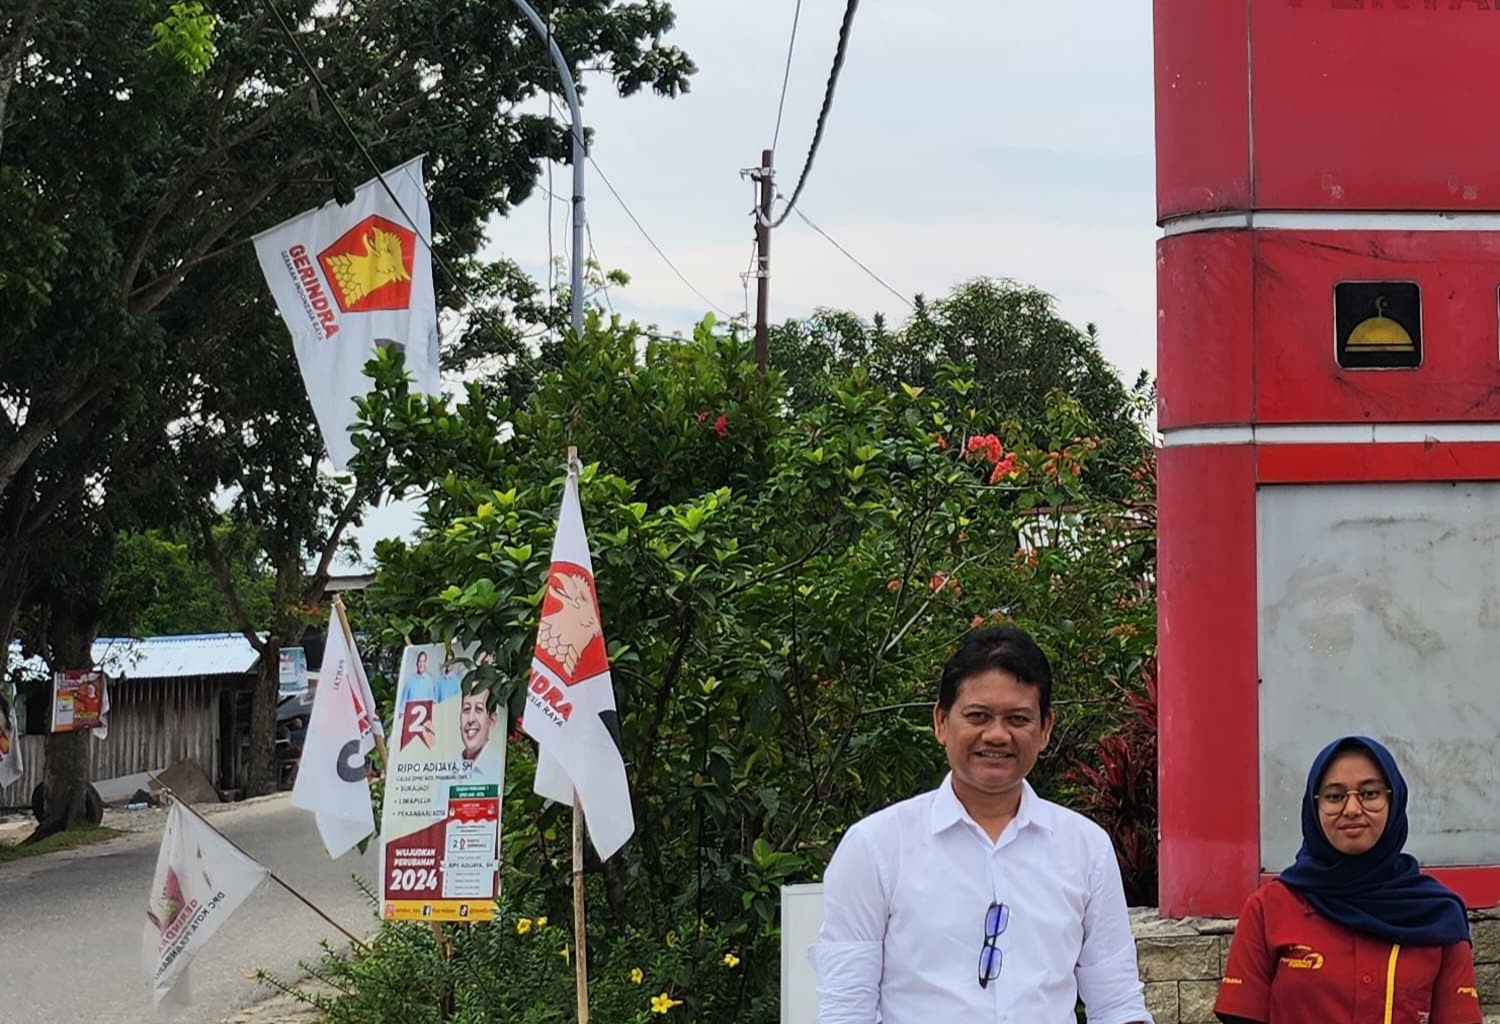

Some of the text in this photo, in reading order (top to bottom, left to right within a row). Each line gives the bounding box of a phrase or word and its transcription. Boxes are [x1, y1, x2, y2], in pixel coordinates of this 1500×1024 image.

[289, 244, 340, 340] GERINDRA
[408, 705, 428, 733] 2
[542, 706, 564, 727] RAYA
[397, 763, 421, 773] RIPO
[389, 868, 438, 891] 2024
